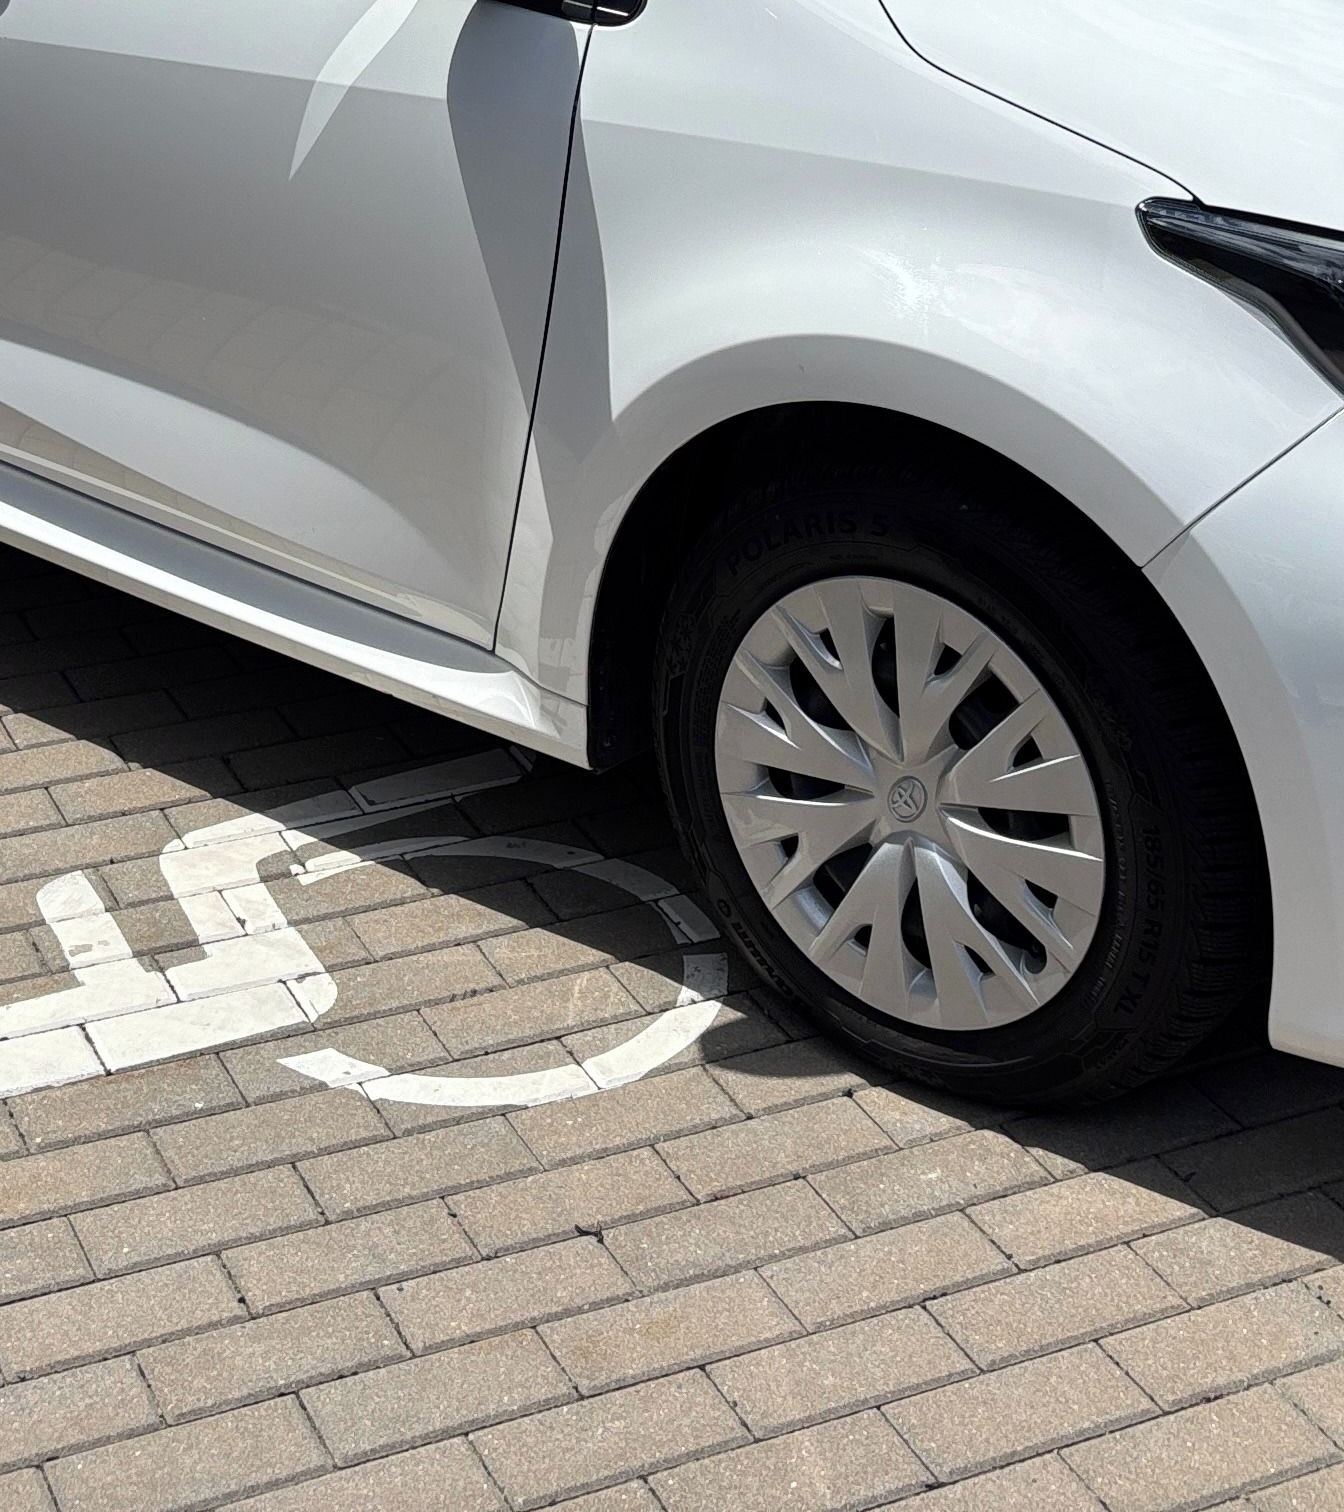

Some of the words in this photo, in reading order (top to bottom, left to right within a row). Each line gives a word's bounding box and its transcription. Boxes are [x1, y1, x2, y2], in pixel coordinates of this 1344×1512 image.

[725, 510, 858, 576] POLARIS
[871, 512, 890, 537] 5
[1142, 825, 1165, 912] 185/65
[1138, 918, 1163, 967] R15
